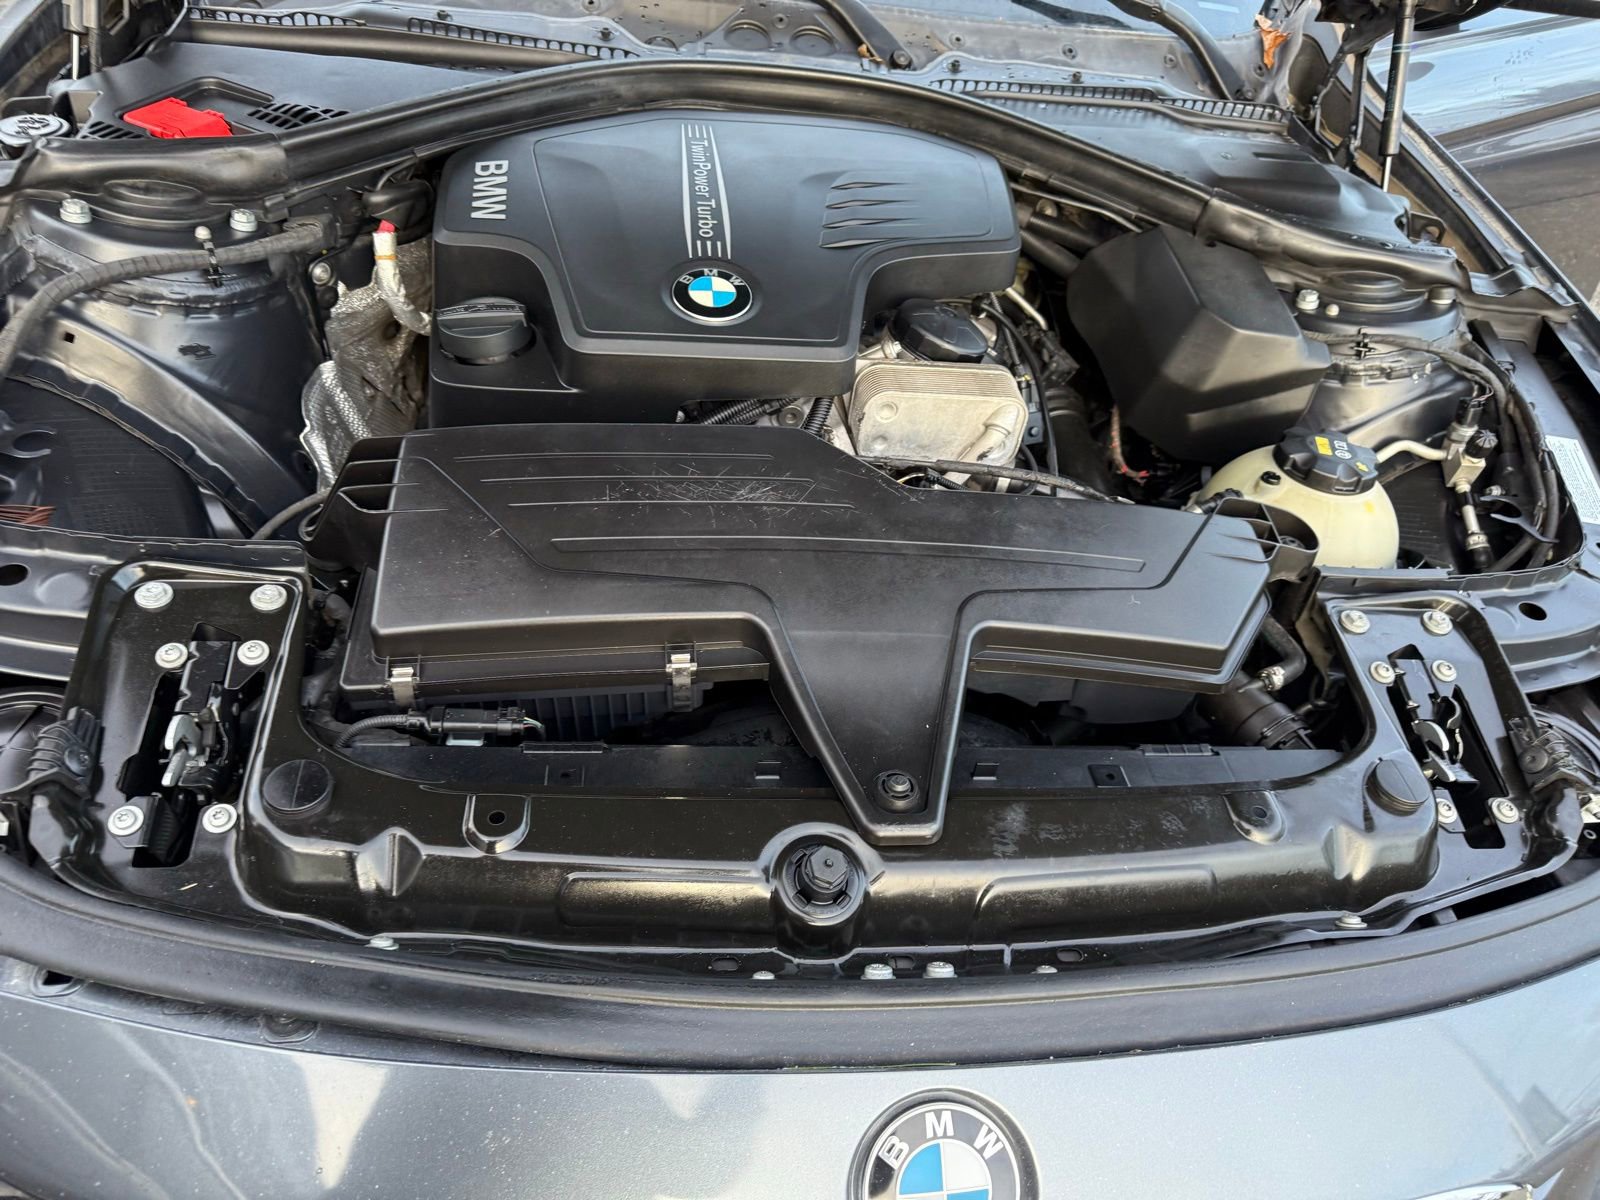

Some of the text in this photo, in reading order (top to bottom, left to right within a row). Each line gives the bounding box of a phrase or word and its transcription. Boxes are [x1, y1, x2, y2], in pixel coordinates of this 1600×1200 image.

[471, 160, 509, 220] BMW
[690, 140, 718, 238] TwinPower Turbo
[679, 268, 745, 286] BMW
[878, 1110, 1007, 1170] BMW
